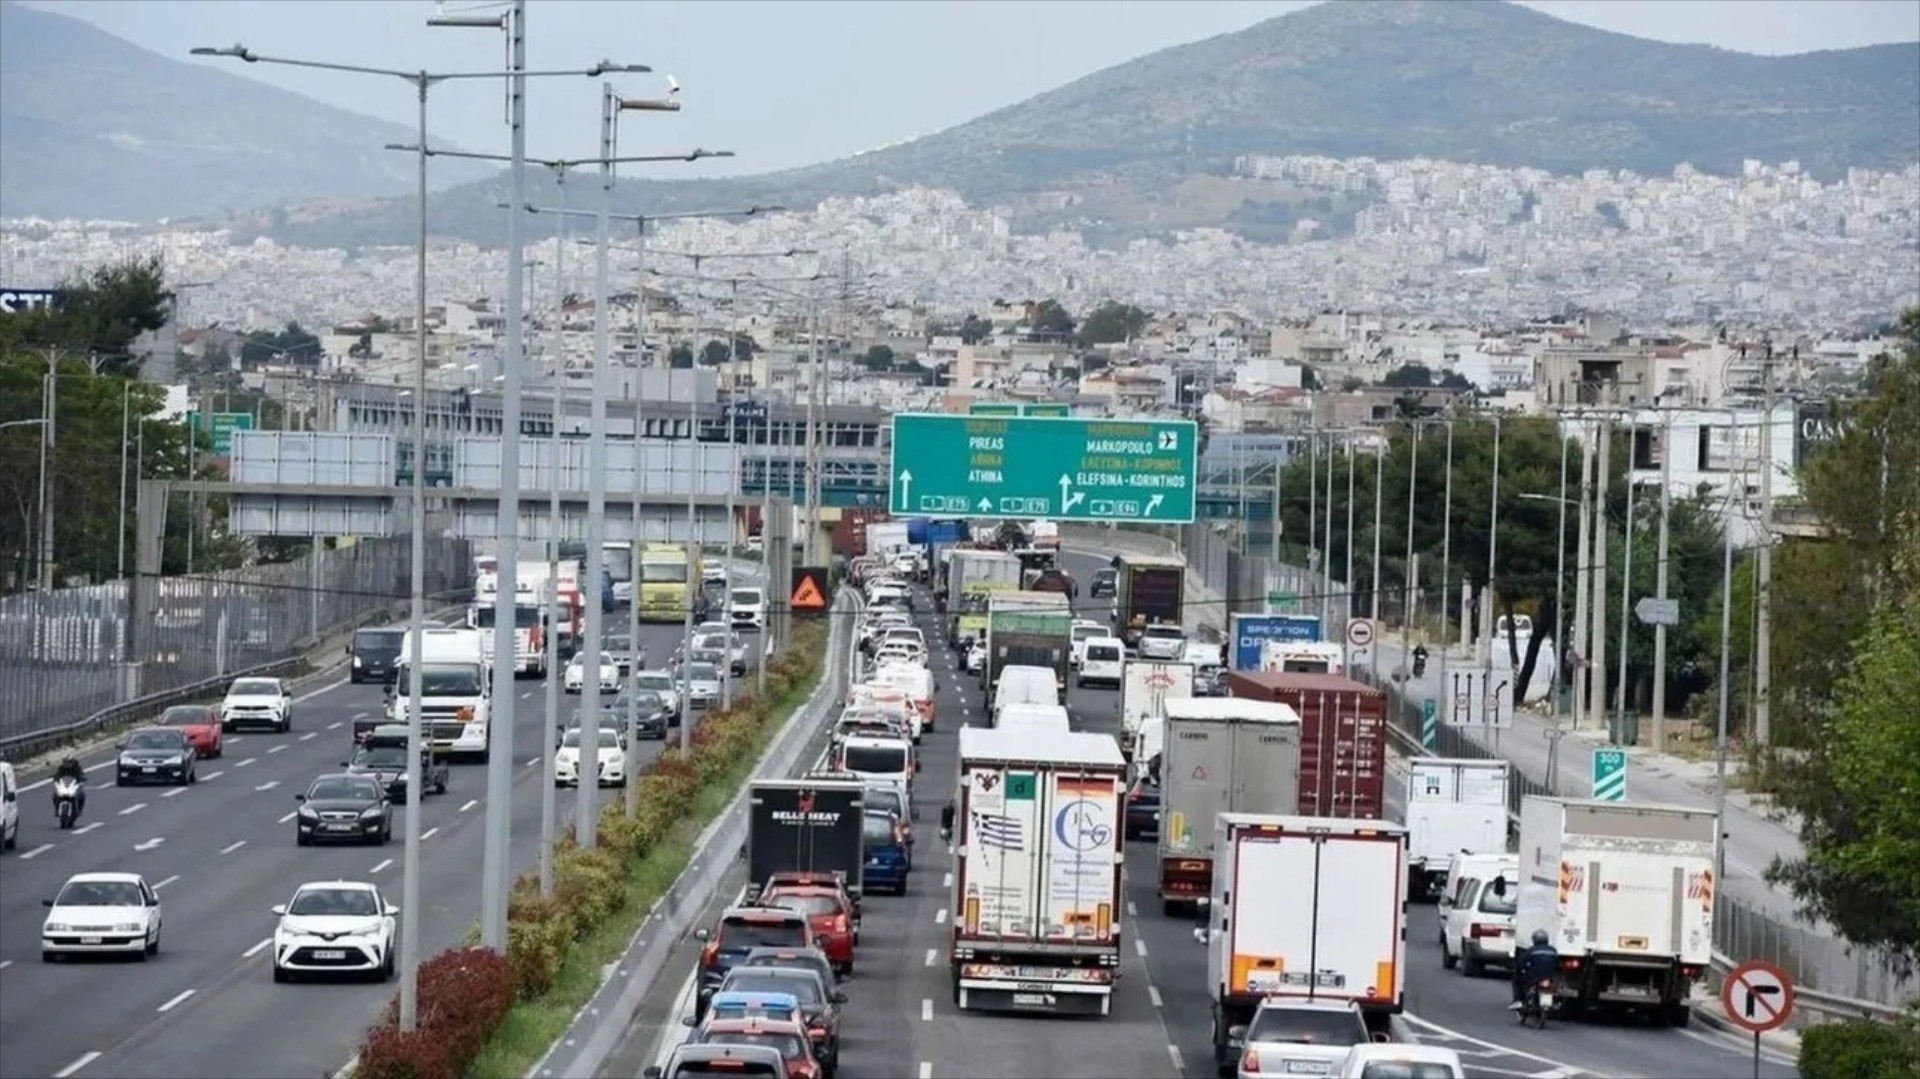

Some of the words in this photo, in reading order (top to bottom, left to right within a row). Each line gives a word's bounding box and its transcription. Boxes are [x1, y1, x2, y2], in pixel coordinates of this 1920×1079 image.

[969, 436, 1004, 450] PIREAS
[1086, 440, 1153, 455] MARKOPOULO
[968, 470, 1003, 484] ATHINA
[1599, 752, 1620, 764] 300
